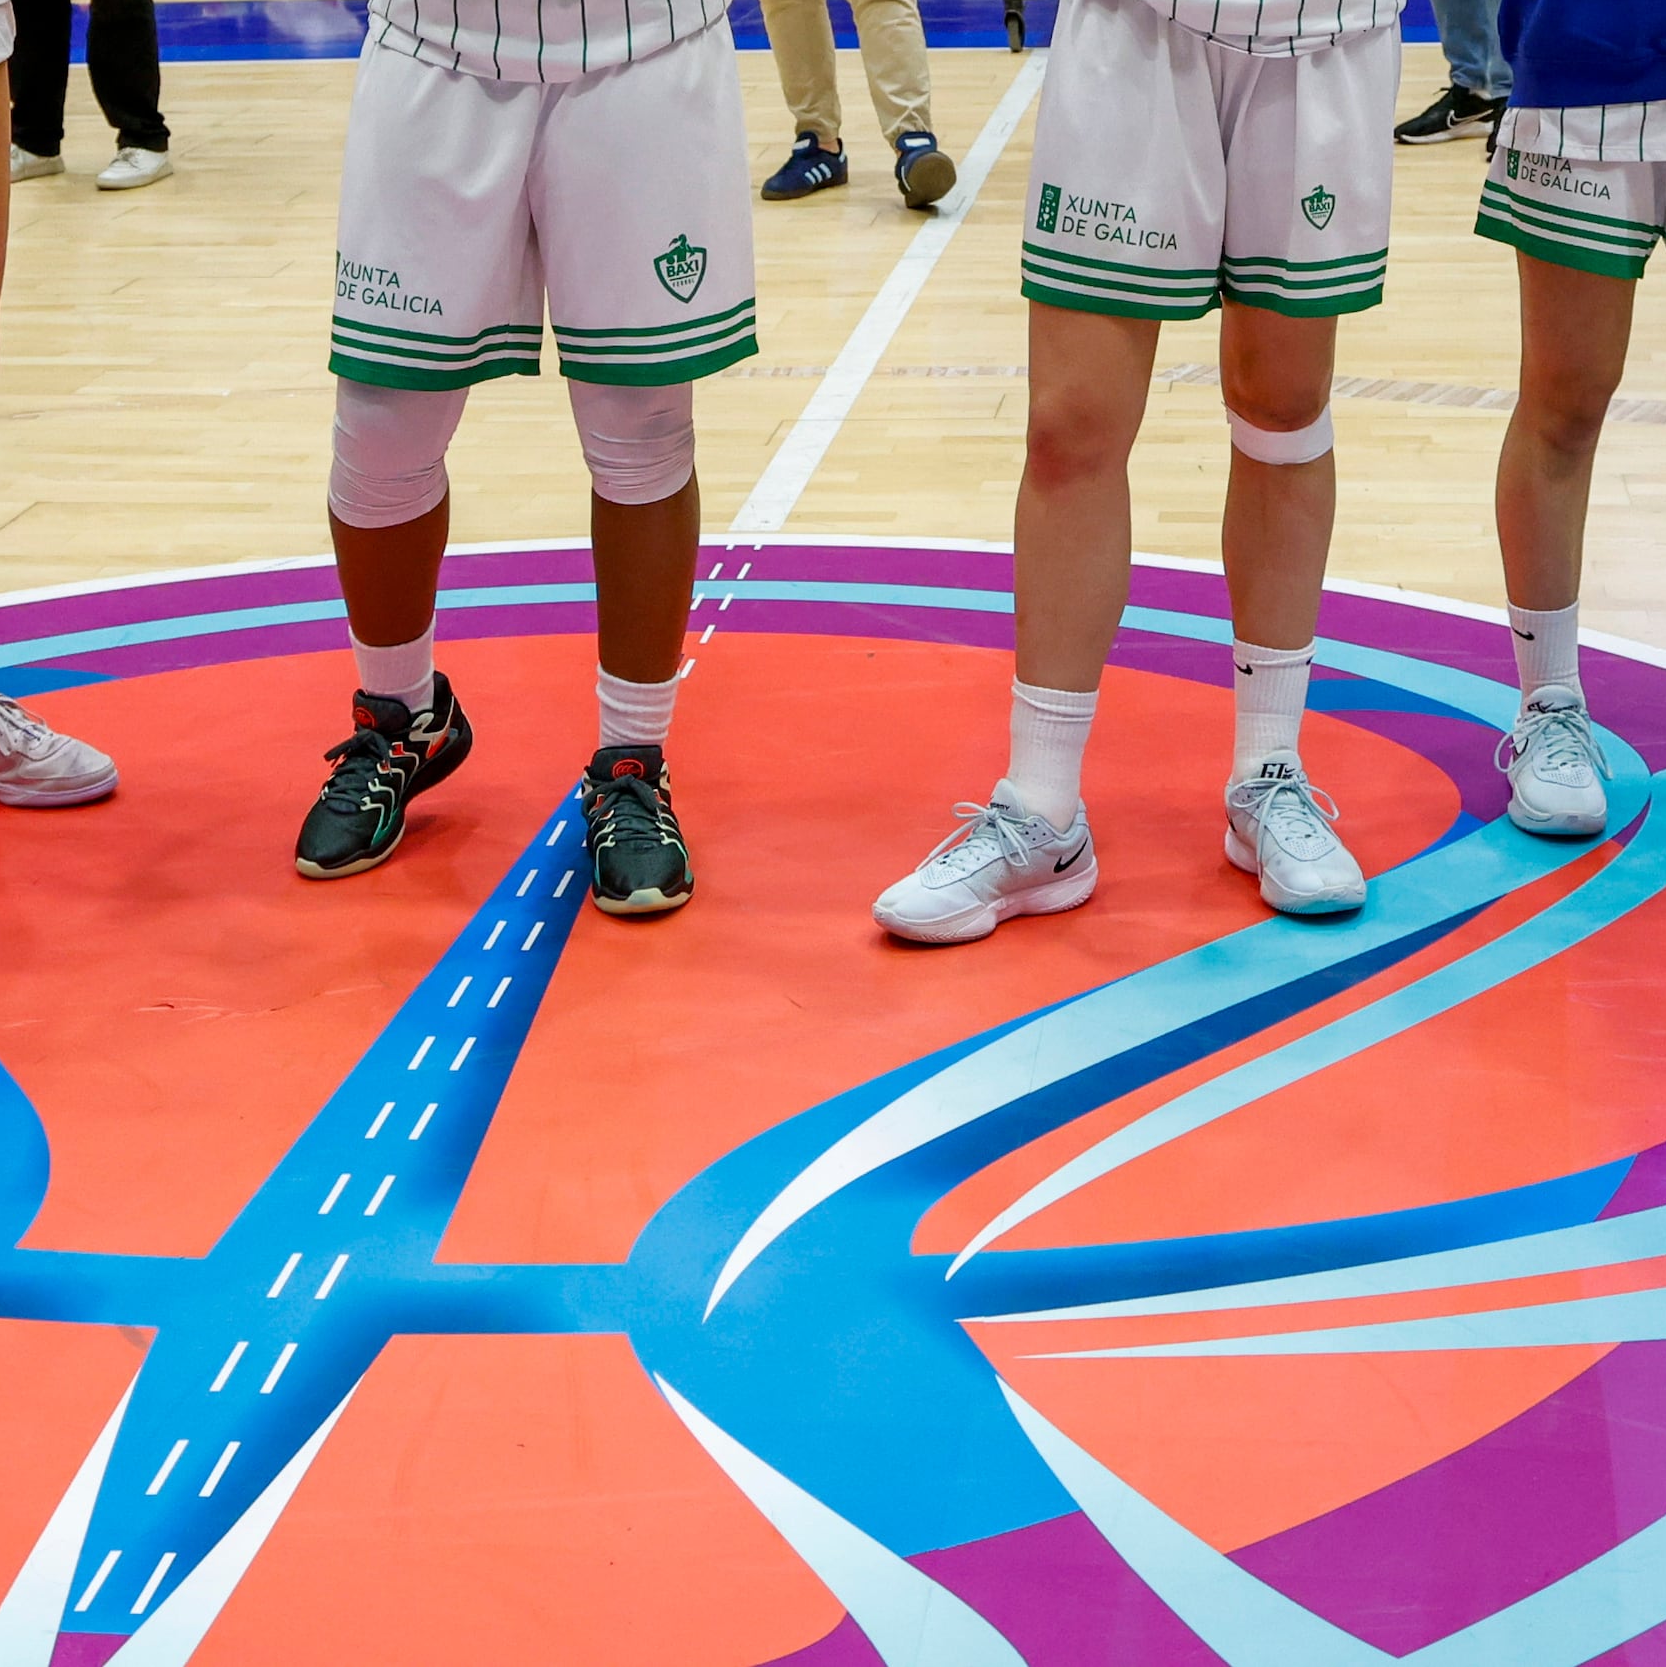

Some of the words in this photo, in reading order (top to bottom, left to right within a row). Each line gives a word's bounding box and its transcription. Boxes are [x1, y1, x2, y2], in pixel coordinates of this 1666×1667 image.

[1520, 166, 1539, 183] DE
[1540, 172, 1611, 201] GALICIA
[1066, 194, 1137, 224] XUNTA
[1061, 216, 1087, 237] DE
[1094, 224, 1178, 251] GALICIA
[340, 261, 401, 289] XUNTA
[666, 259, 699, 278] BAXI
[336, 279, 357, 301] DE
[361, 288, 444, 317] GALICIA
